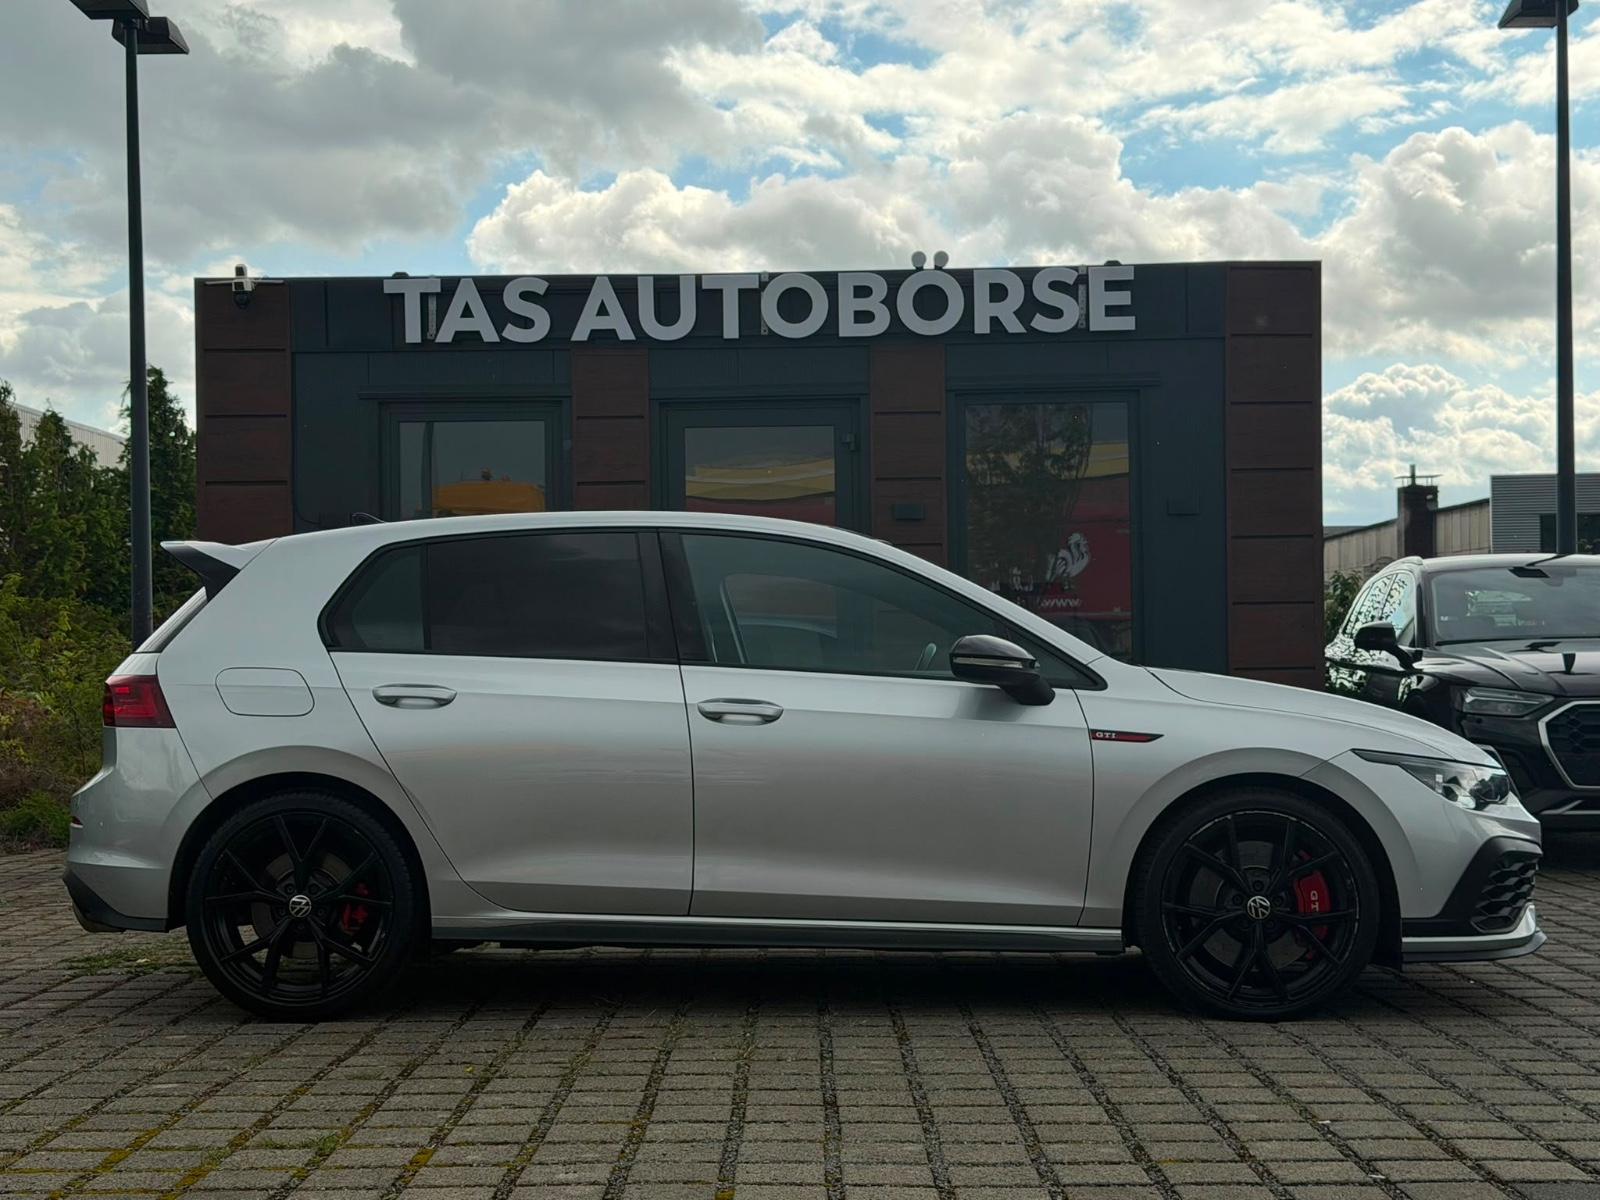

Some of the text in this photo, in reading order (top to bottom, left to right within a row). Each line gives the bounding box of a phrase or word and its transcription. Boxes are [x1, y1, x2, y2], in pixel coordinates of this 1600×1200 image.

[383, 250, 1136, 344] TAS AUTOBÖRSE
[1095, 731, 1117, 739] GTI
[1310, 890, 1320, 913] GT
